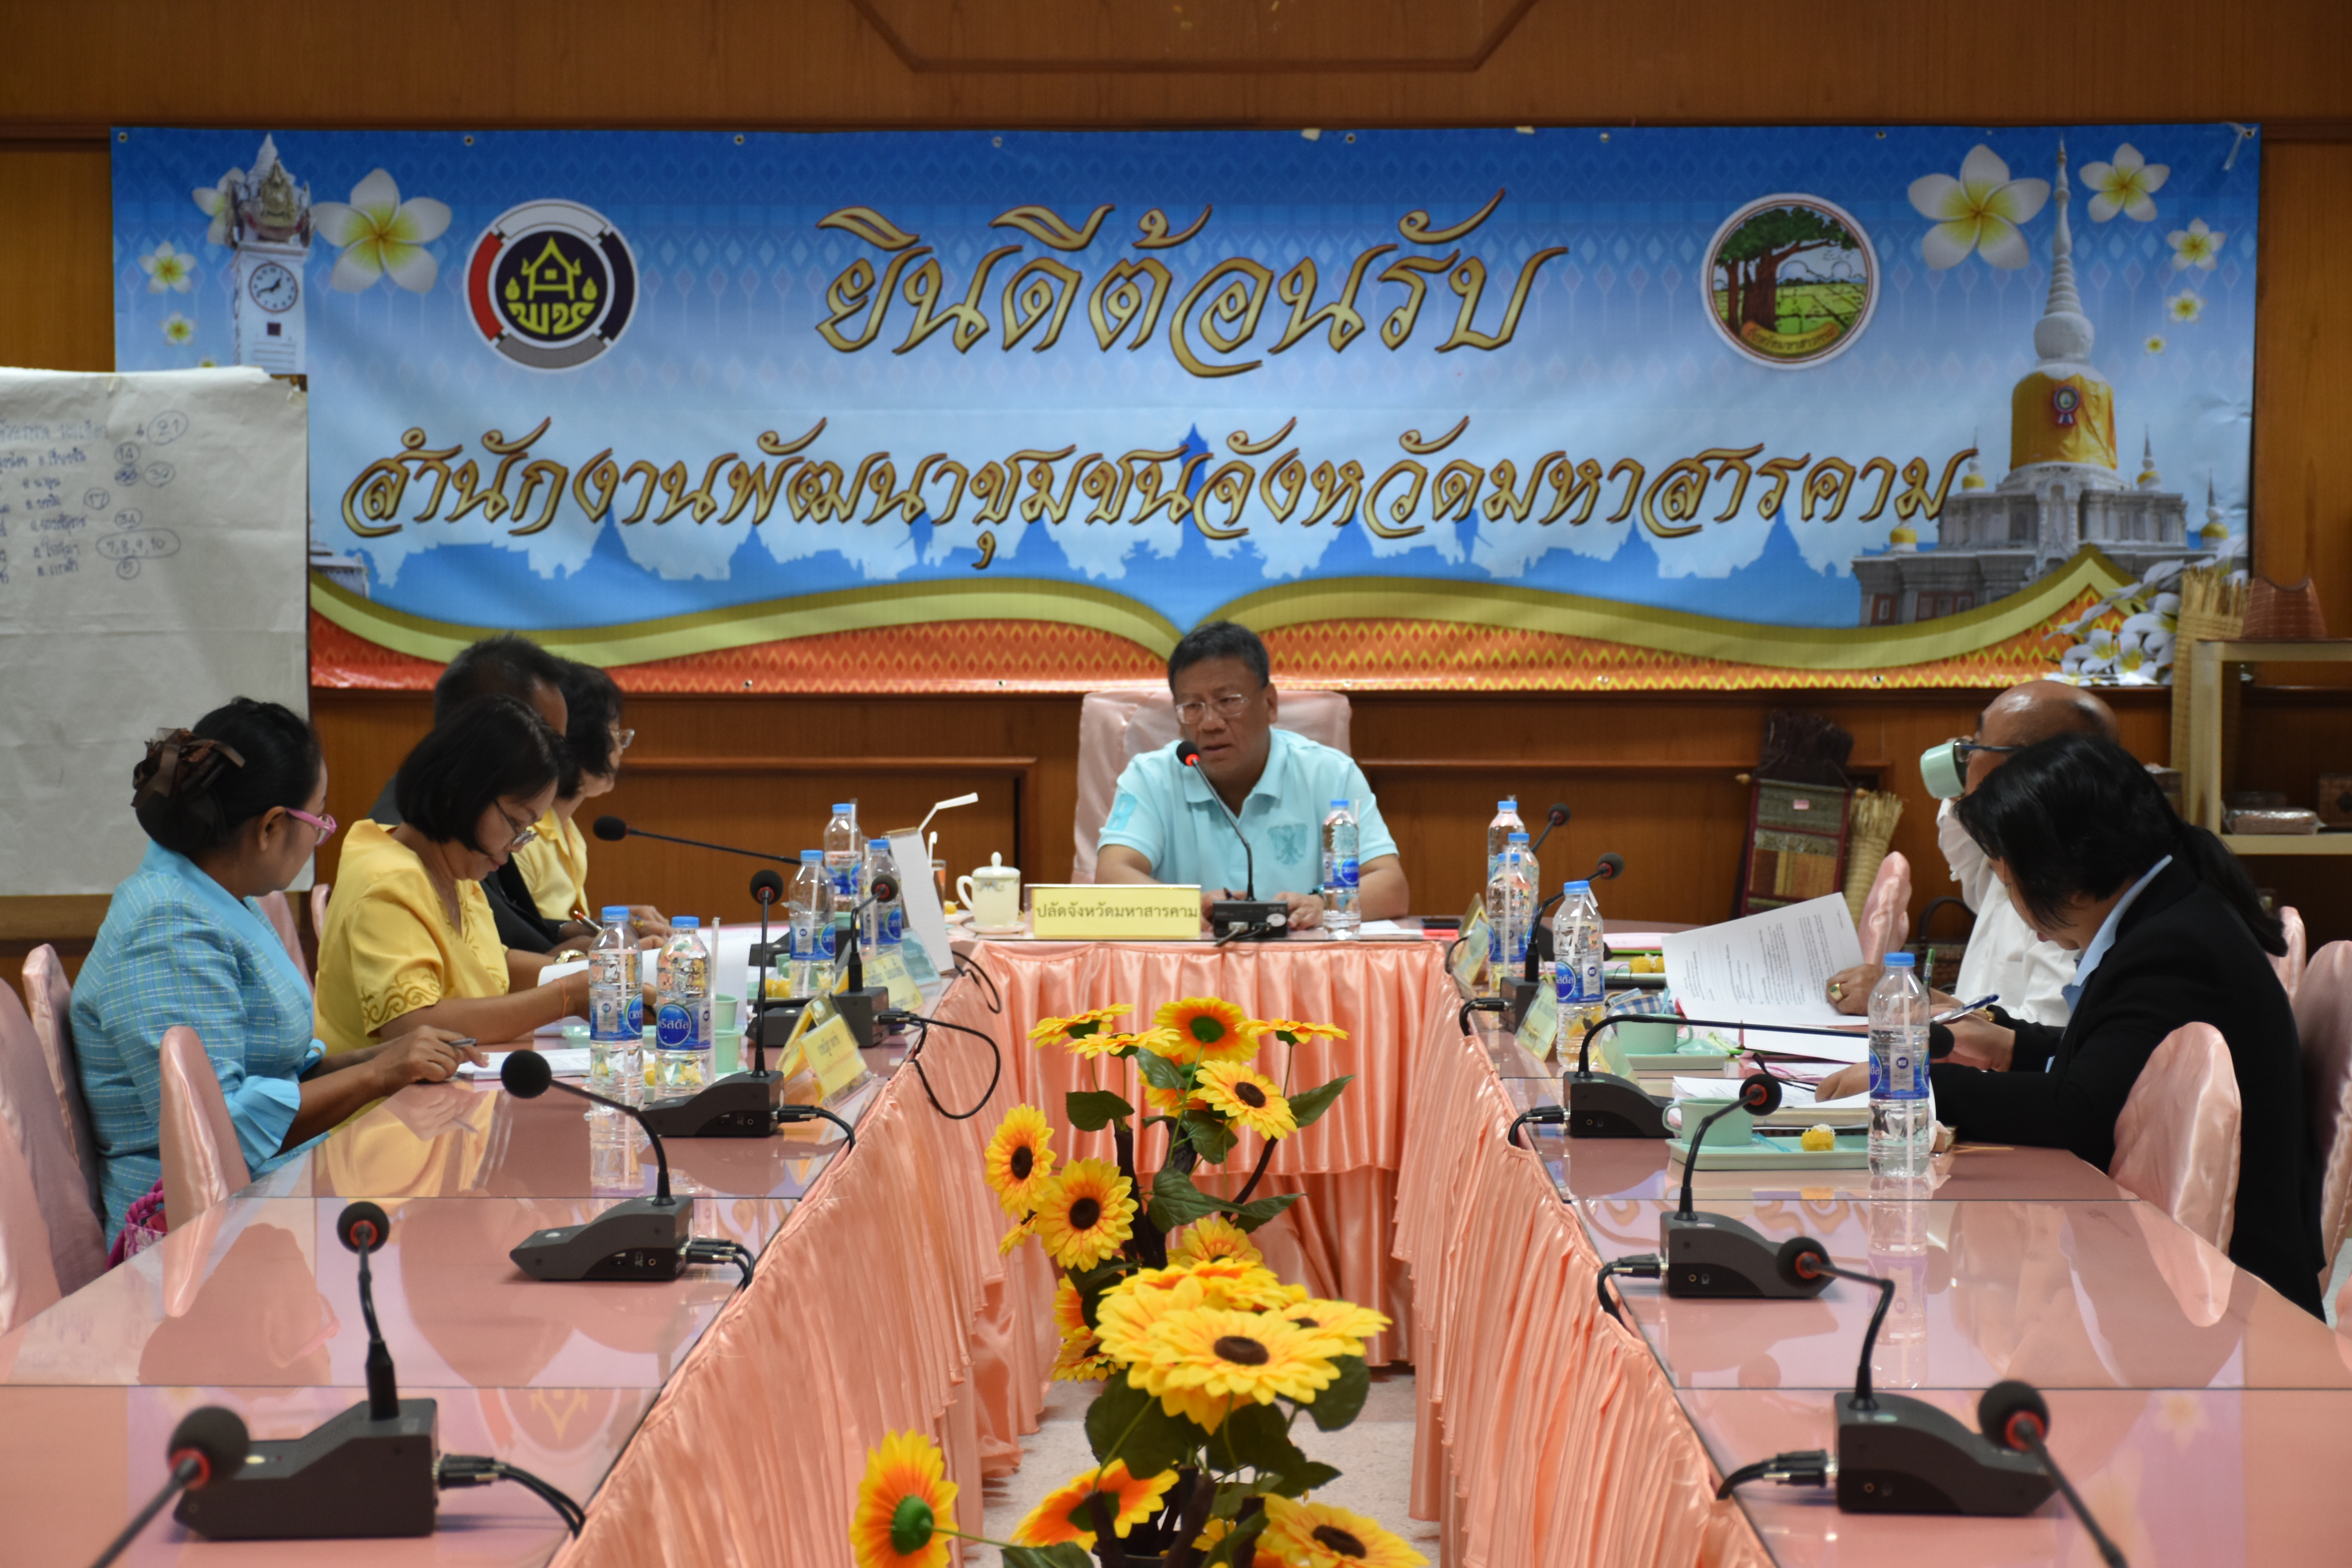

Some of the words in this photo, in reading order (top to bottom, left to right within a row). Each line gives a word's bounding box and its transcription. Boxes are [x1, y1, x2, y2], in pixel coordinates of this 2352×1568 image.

[815, 188, 1568, 377] ยินดีต้อนรับ
[342, 416, 1978, 570] สำนักงานพัฒนาชุมชนจังหวัดมหาสารคาม
[1036, 901, 1198, 918] ปลัดจังหวัดมหาสารคาม
